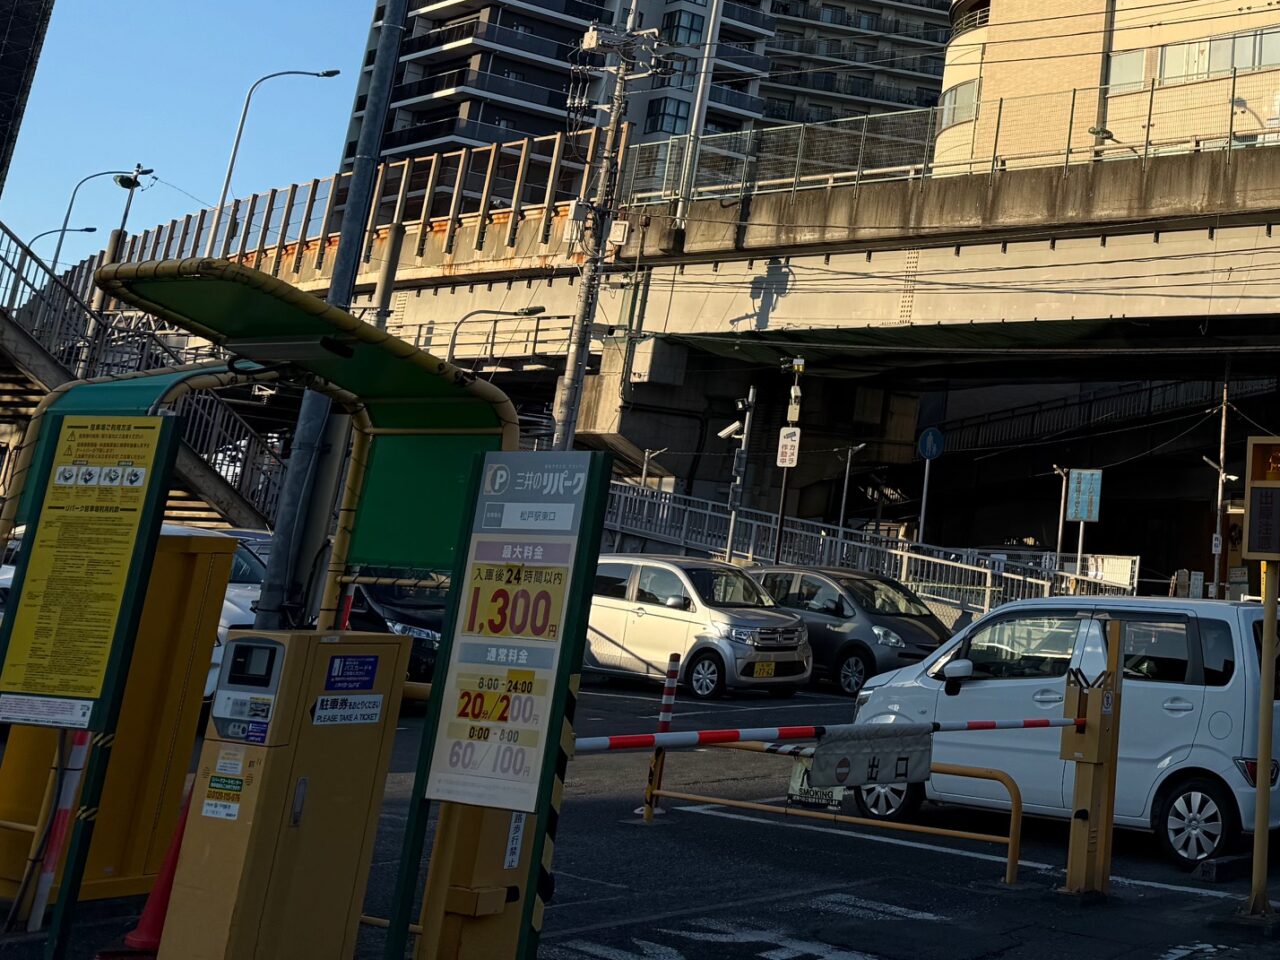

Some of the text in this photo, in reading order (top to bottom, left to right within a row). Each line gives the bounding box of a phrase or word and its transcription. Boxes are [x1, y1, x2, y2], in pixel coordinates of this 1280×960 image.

[514, 470, 586, 495] 三井のリパーク
[520, 511, 556, 521] 松戸駅東口
[502, 544, 544, 559] 最大料金
[474, 567, 563, 584] 入庫後24時間以内
[486, 647, 529, 664] 通常料金
[478, 677, 499, 690] 8:00
[507, 680, 533, 693] 24:00
[316, 714, 338, 723] PLEASE
[340, 713, 353, 721] TAKE
[359, 712, 378, 720] TICKET
[468, 726, 490, 739] 0:00
[499, 729, 519, 742] 8:00
[867, 756, 909, 781] 出口
[799, 788, 834, 798] SMOKING
